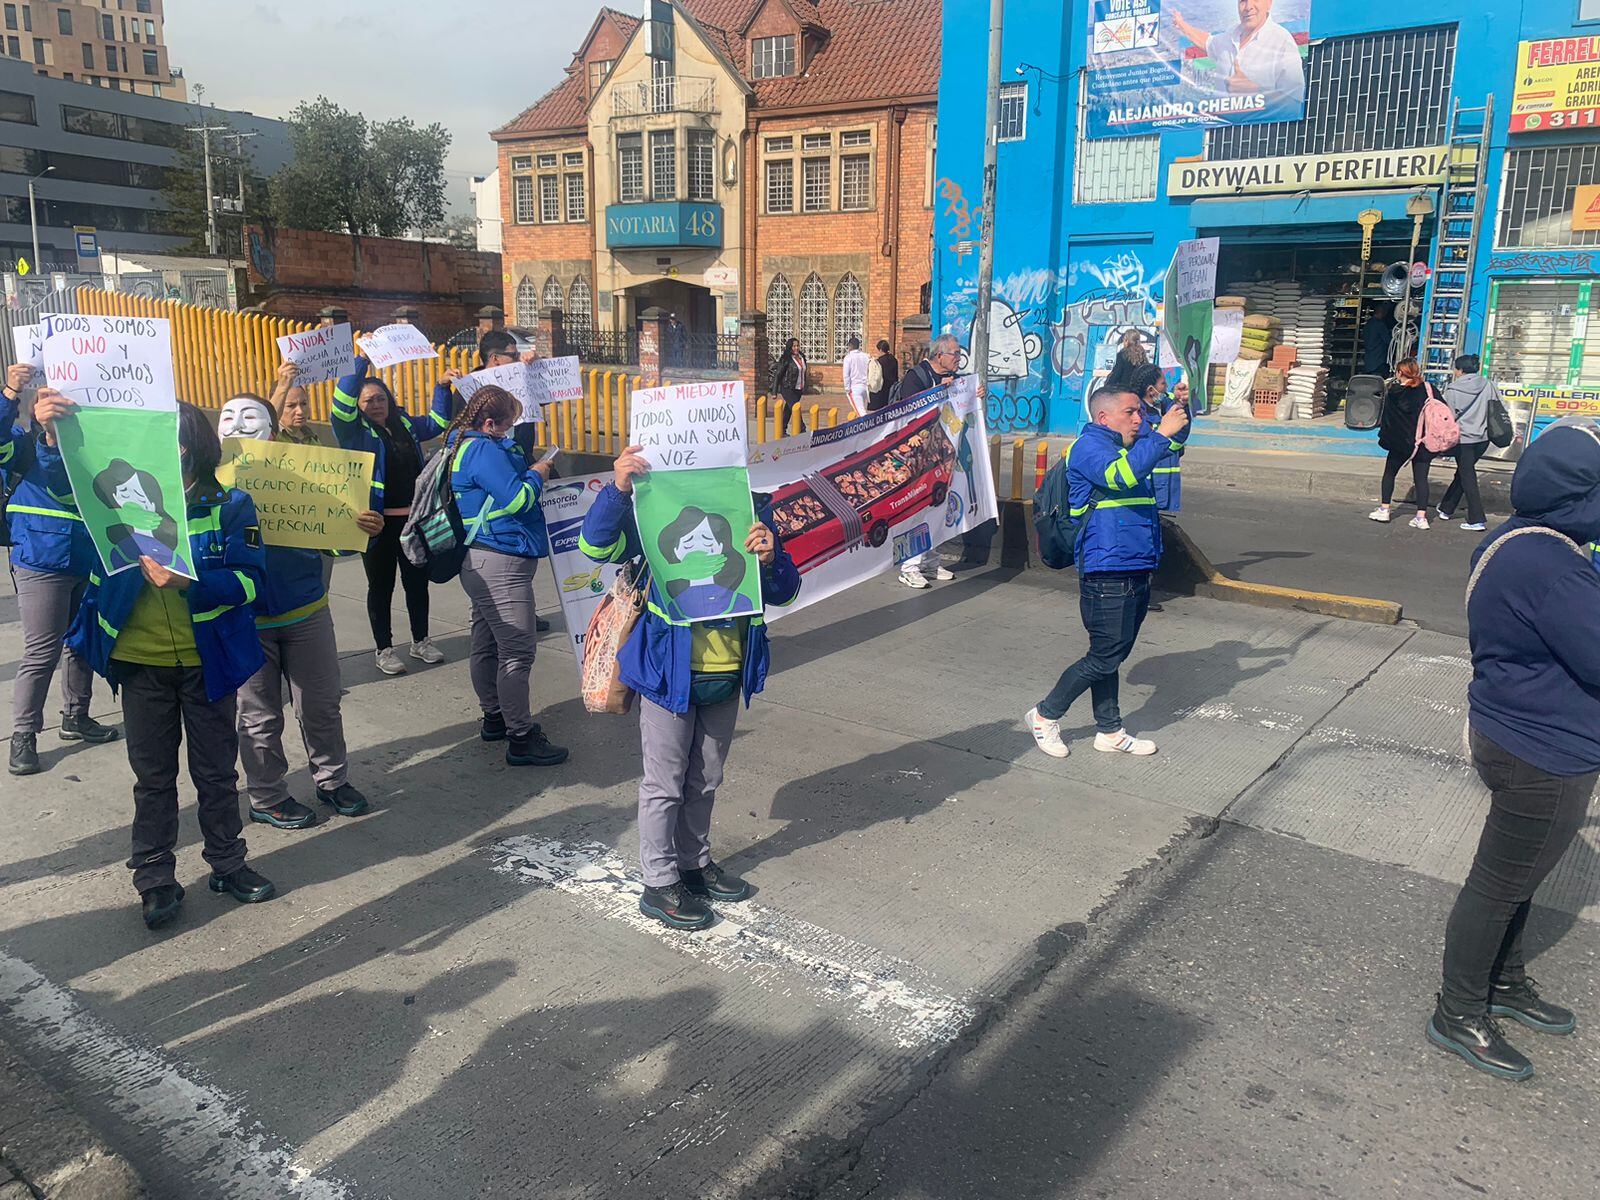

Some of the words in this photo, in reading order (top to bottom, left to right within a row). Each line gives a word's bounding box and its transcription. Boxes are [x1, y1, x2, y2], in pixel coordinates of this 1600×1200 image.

[1137, 21, 1159, 39] 17
[1527, 37, 1600, 68] FERREL
[1128, 68, 1149, 77] Juntos
[1567, 81, 1600, 94] LADRI
[1107, 101, 1194, 123] ALEJANDRO
[1197, 94, 1265, 113] CHEMAS
[1152, 118, 1186, 127] CONCEJO
[1549, 109, 1596, 127] 311
[1181, 165, 1284, 188] DRYWALL
[1293, 162, 1308, 182] Y
[609, 215, 676, 235] NOTARIA
[685, 210, 716, 237] 48
[41, 313, 91, 341] TODOS
[104, 317, 157, 338] SOMOS
[72, 336, 106, 355] UNO
[118, 344, 128, 360] Y
[334, 346, 341, 357] A
[321, 356, 349, 369] HABLAN
[47, 361, 79, 382] UNO
[96, 362, 154, 385] SOMOS
[69, 386, 145, 408] TODOS
[642, 388, 666, 405] SIN
[1556, 401, 1598, 411] 90%
[633, 408, 673, 430] TODOS
[687, 403, 736, 425] UNIDOS
[811, 429, 844, 446] SINDICATO
[845, 420, 876, 437] NACIONAL
[876, 414, 884, 424] DE
[885, 399, 928, 420] TRABAJADORES
[926, 391, 939, 404] DEL
[638, 432, 660, 447] EN
[667, 429, 699, 446] UNA
[706, 427, 741, 445] SOLA
[232, 452, 255, 467] NO
[264, 453, 296, 471] MÁS
[303, 462, 363, 479] ABUSO!!!
[660, 449, 698, 466] VOZ
[234, 477, 296, 492] RECAUDO
[301, 477, 349, 496] BOGOTÁ
[541, 493, 578, 508] onsorcio
[254, 502, 316, 518] NECESITA
[327, 502, 353, 520] MÁS
[259, 518, 327, 535] PERSONAL
[554, 535, 580, 548] EXPR
